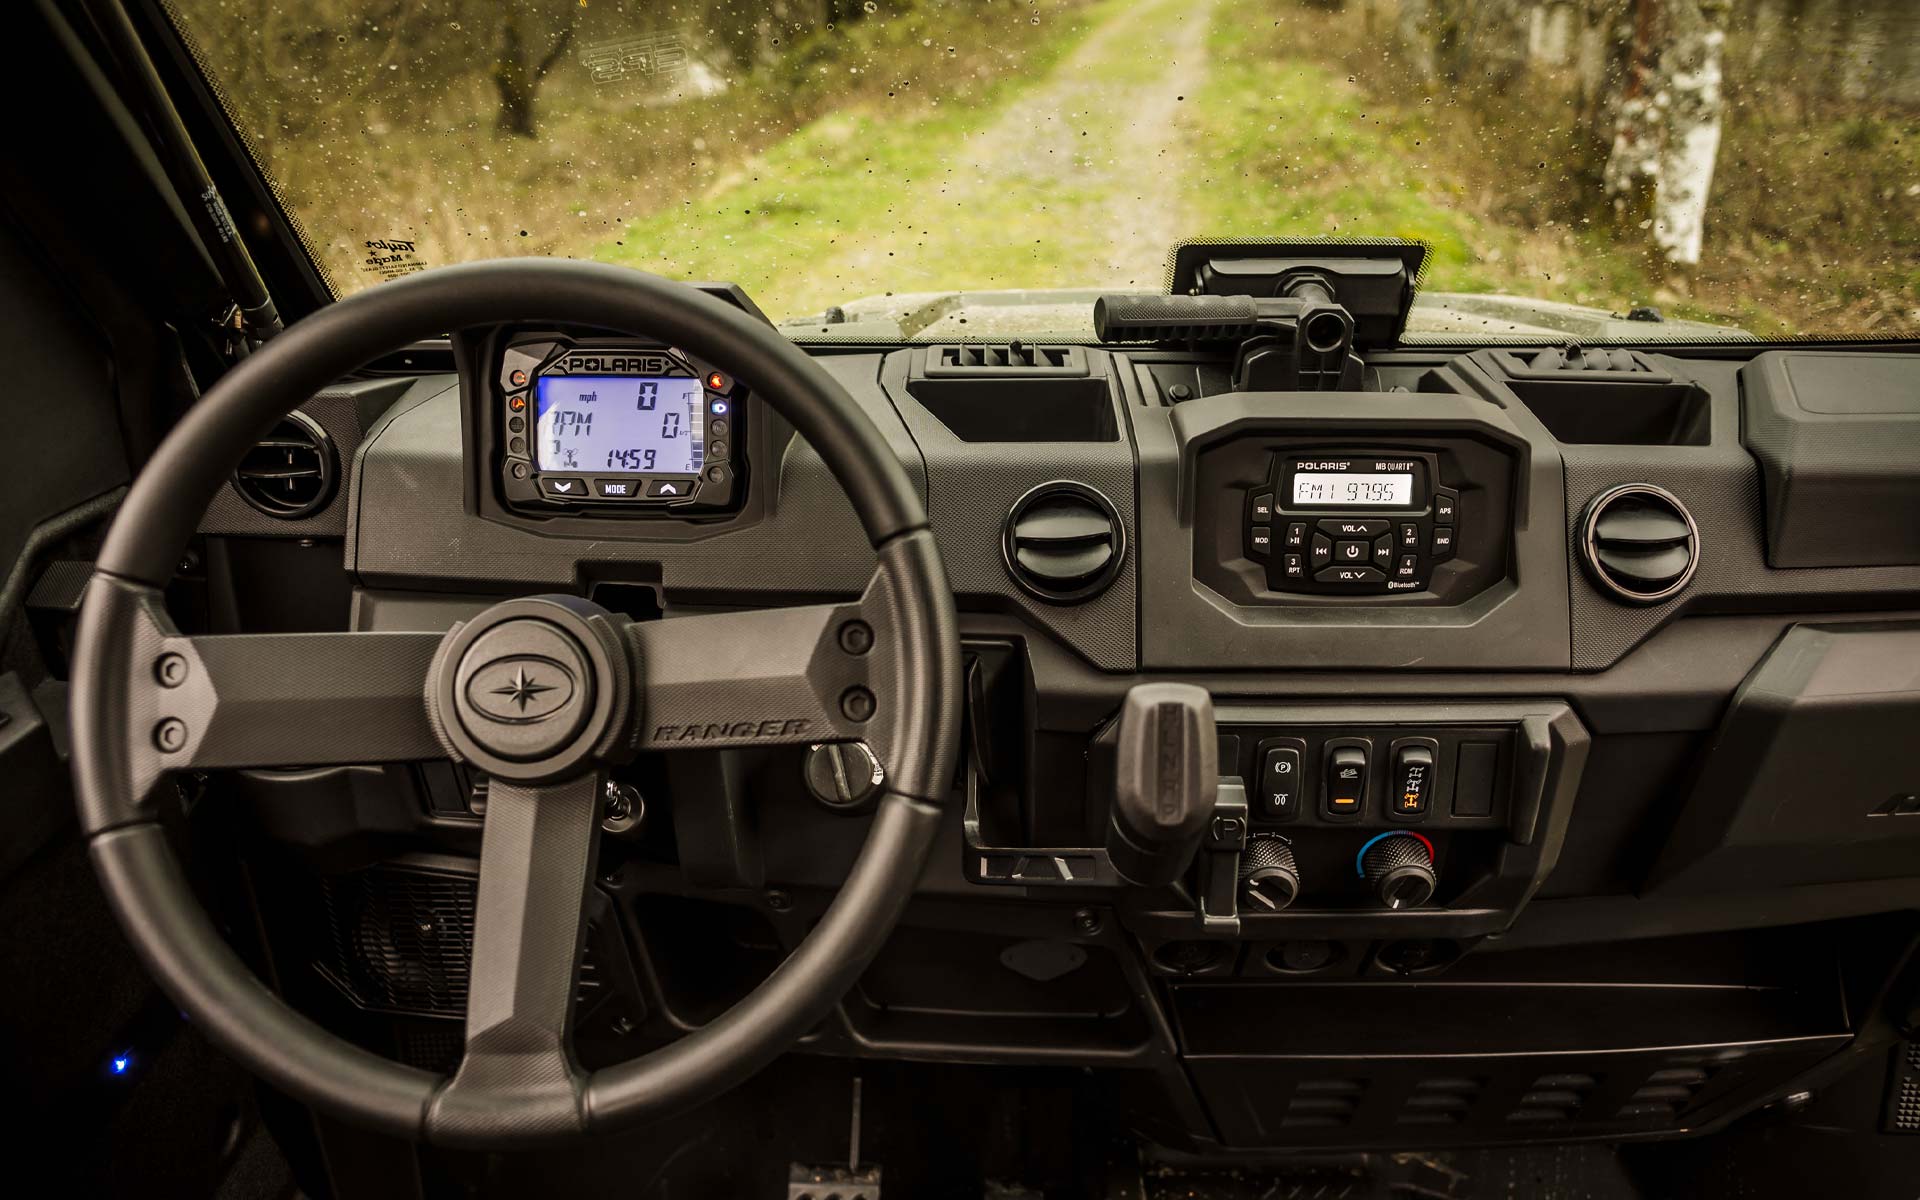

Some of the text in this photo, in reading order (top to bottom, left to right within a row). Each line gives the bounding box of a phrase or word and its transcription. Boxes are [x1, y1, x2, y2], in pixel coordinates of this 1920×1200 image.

[569, 358, 662, 372] POLARIS
[579, 391, 597, 404] mph
[637, 382, 658, 410] 0
[662, 413, 680, 438] 0
[607, 449, 656, 469] 14:59
[1297, 462, 1347, 470] POLARIS
[605, 484, 626, 494] MODE
[1299, 482, 1335, 499] FM1
[653, 719, 812, 741] RANGER
